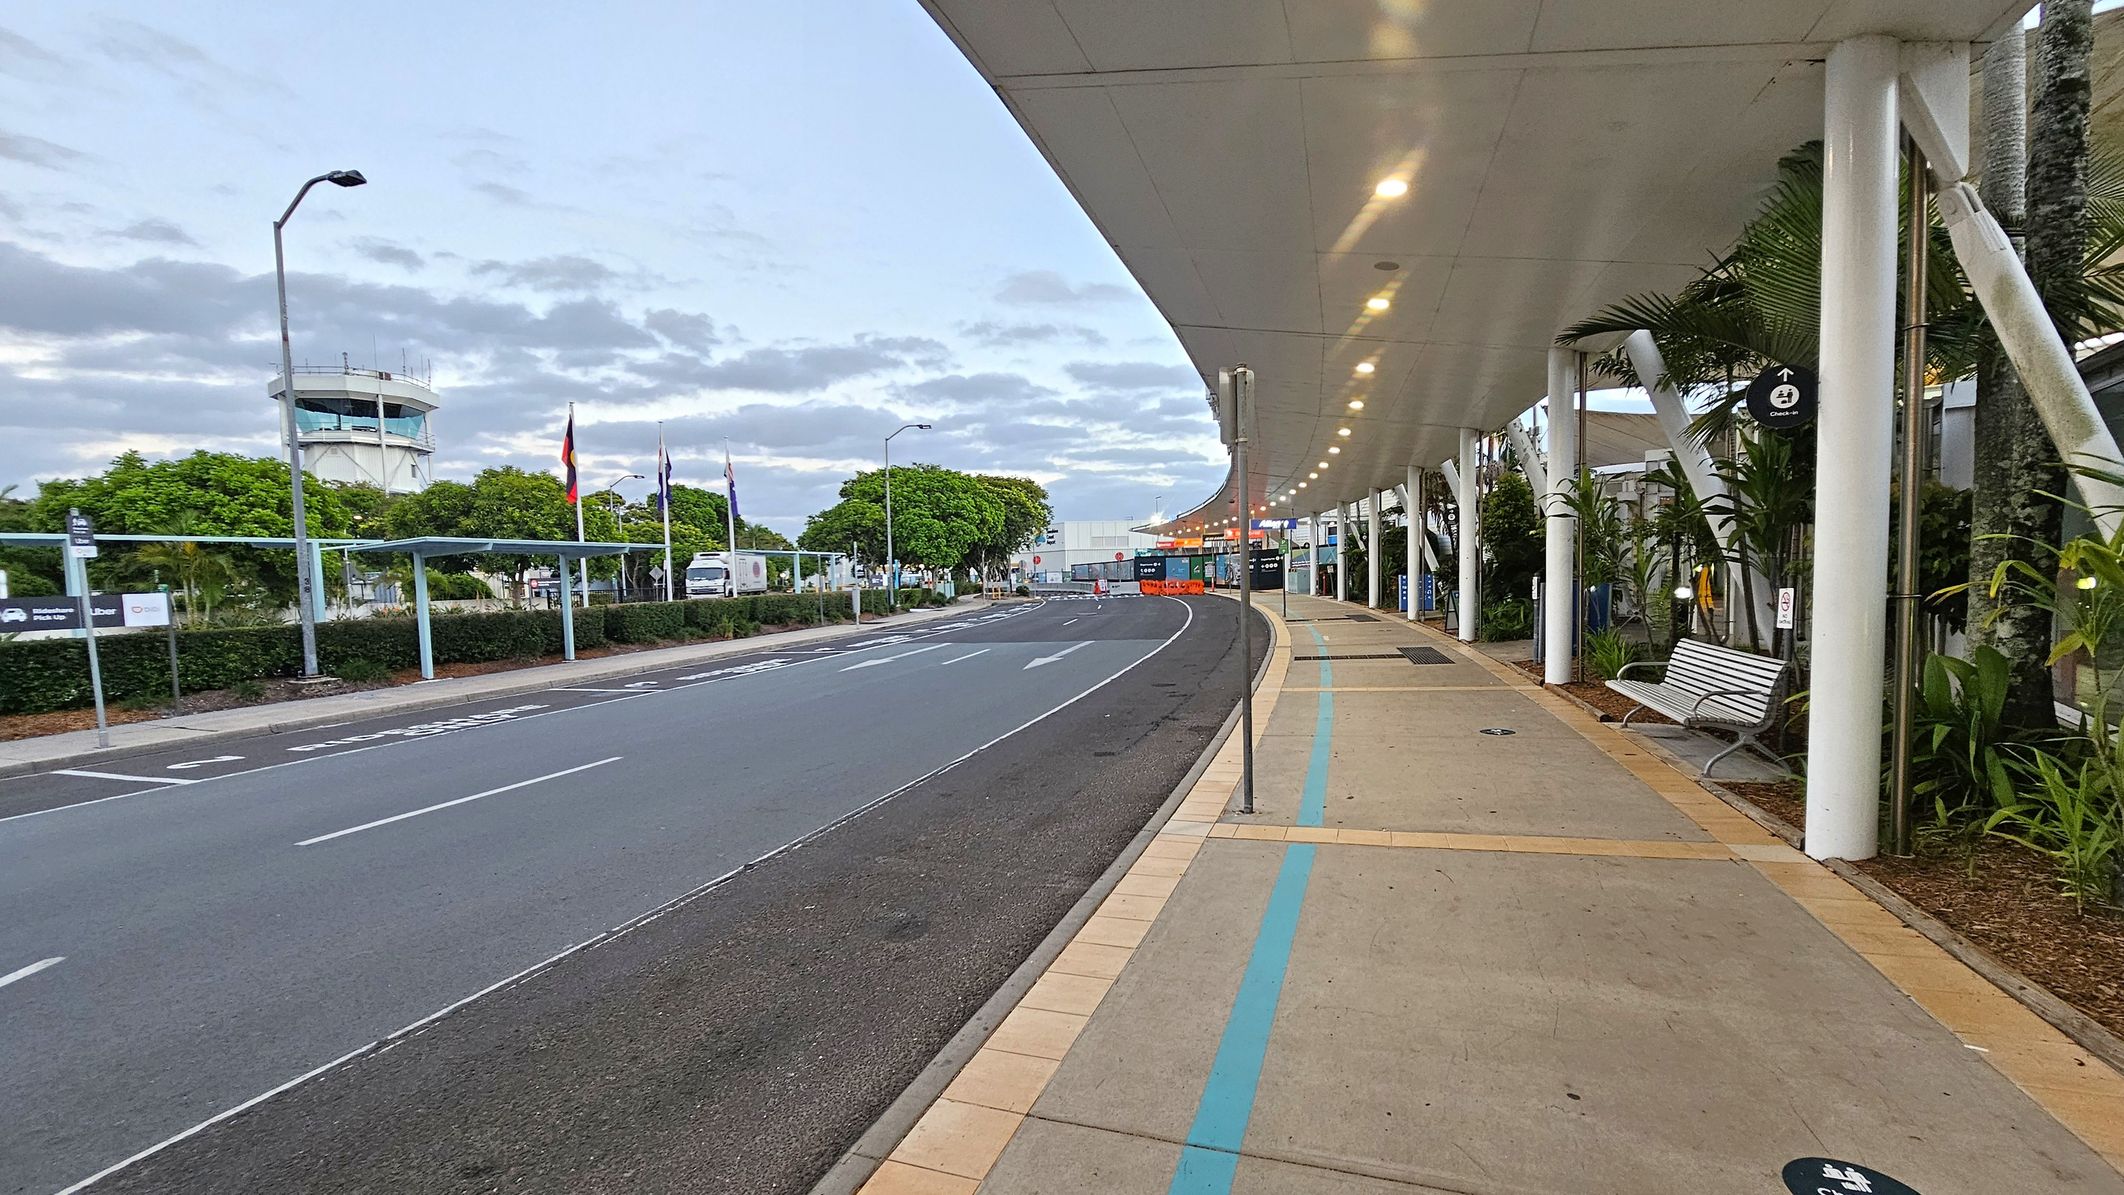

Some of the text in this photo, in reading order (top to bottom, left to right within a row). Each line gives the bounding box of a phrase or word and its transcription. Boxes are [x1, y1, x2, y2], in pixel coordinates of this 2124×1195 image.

[32, 607, 75, 615] Rideshare
[89, 608, 117, 616] Uber
[284, 704, 551, 752] RIDESHARE
